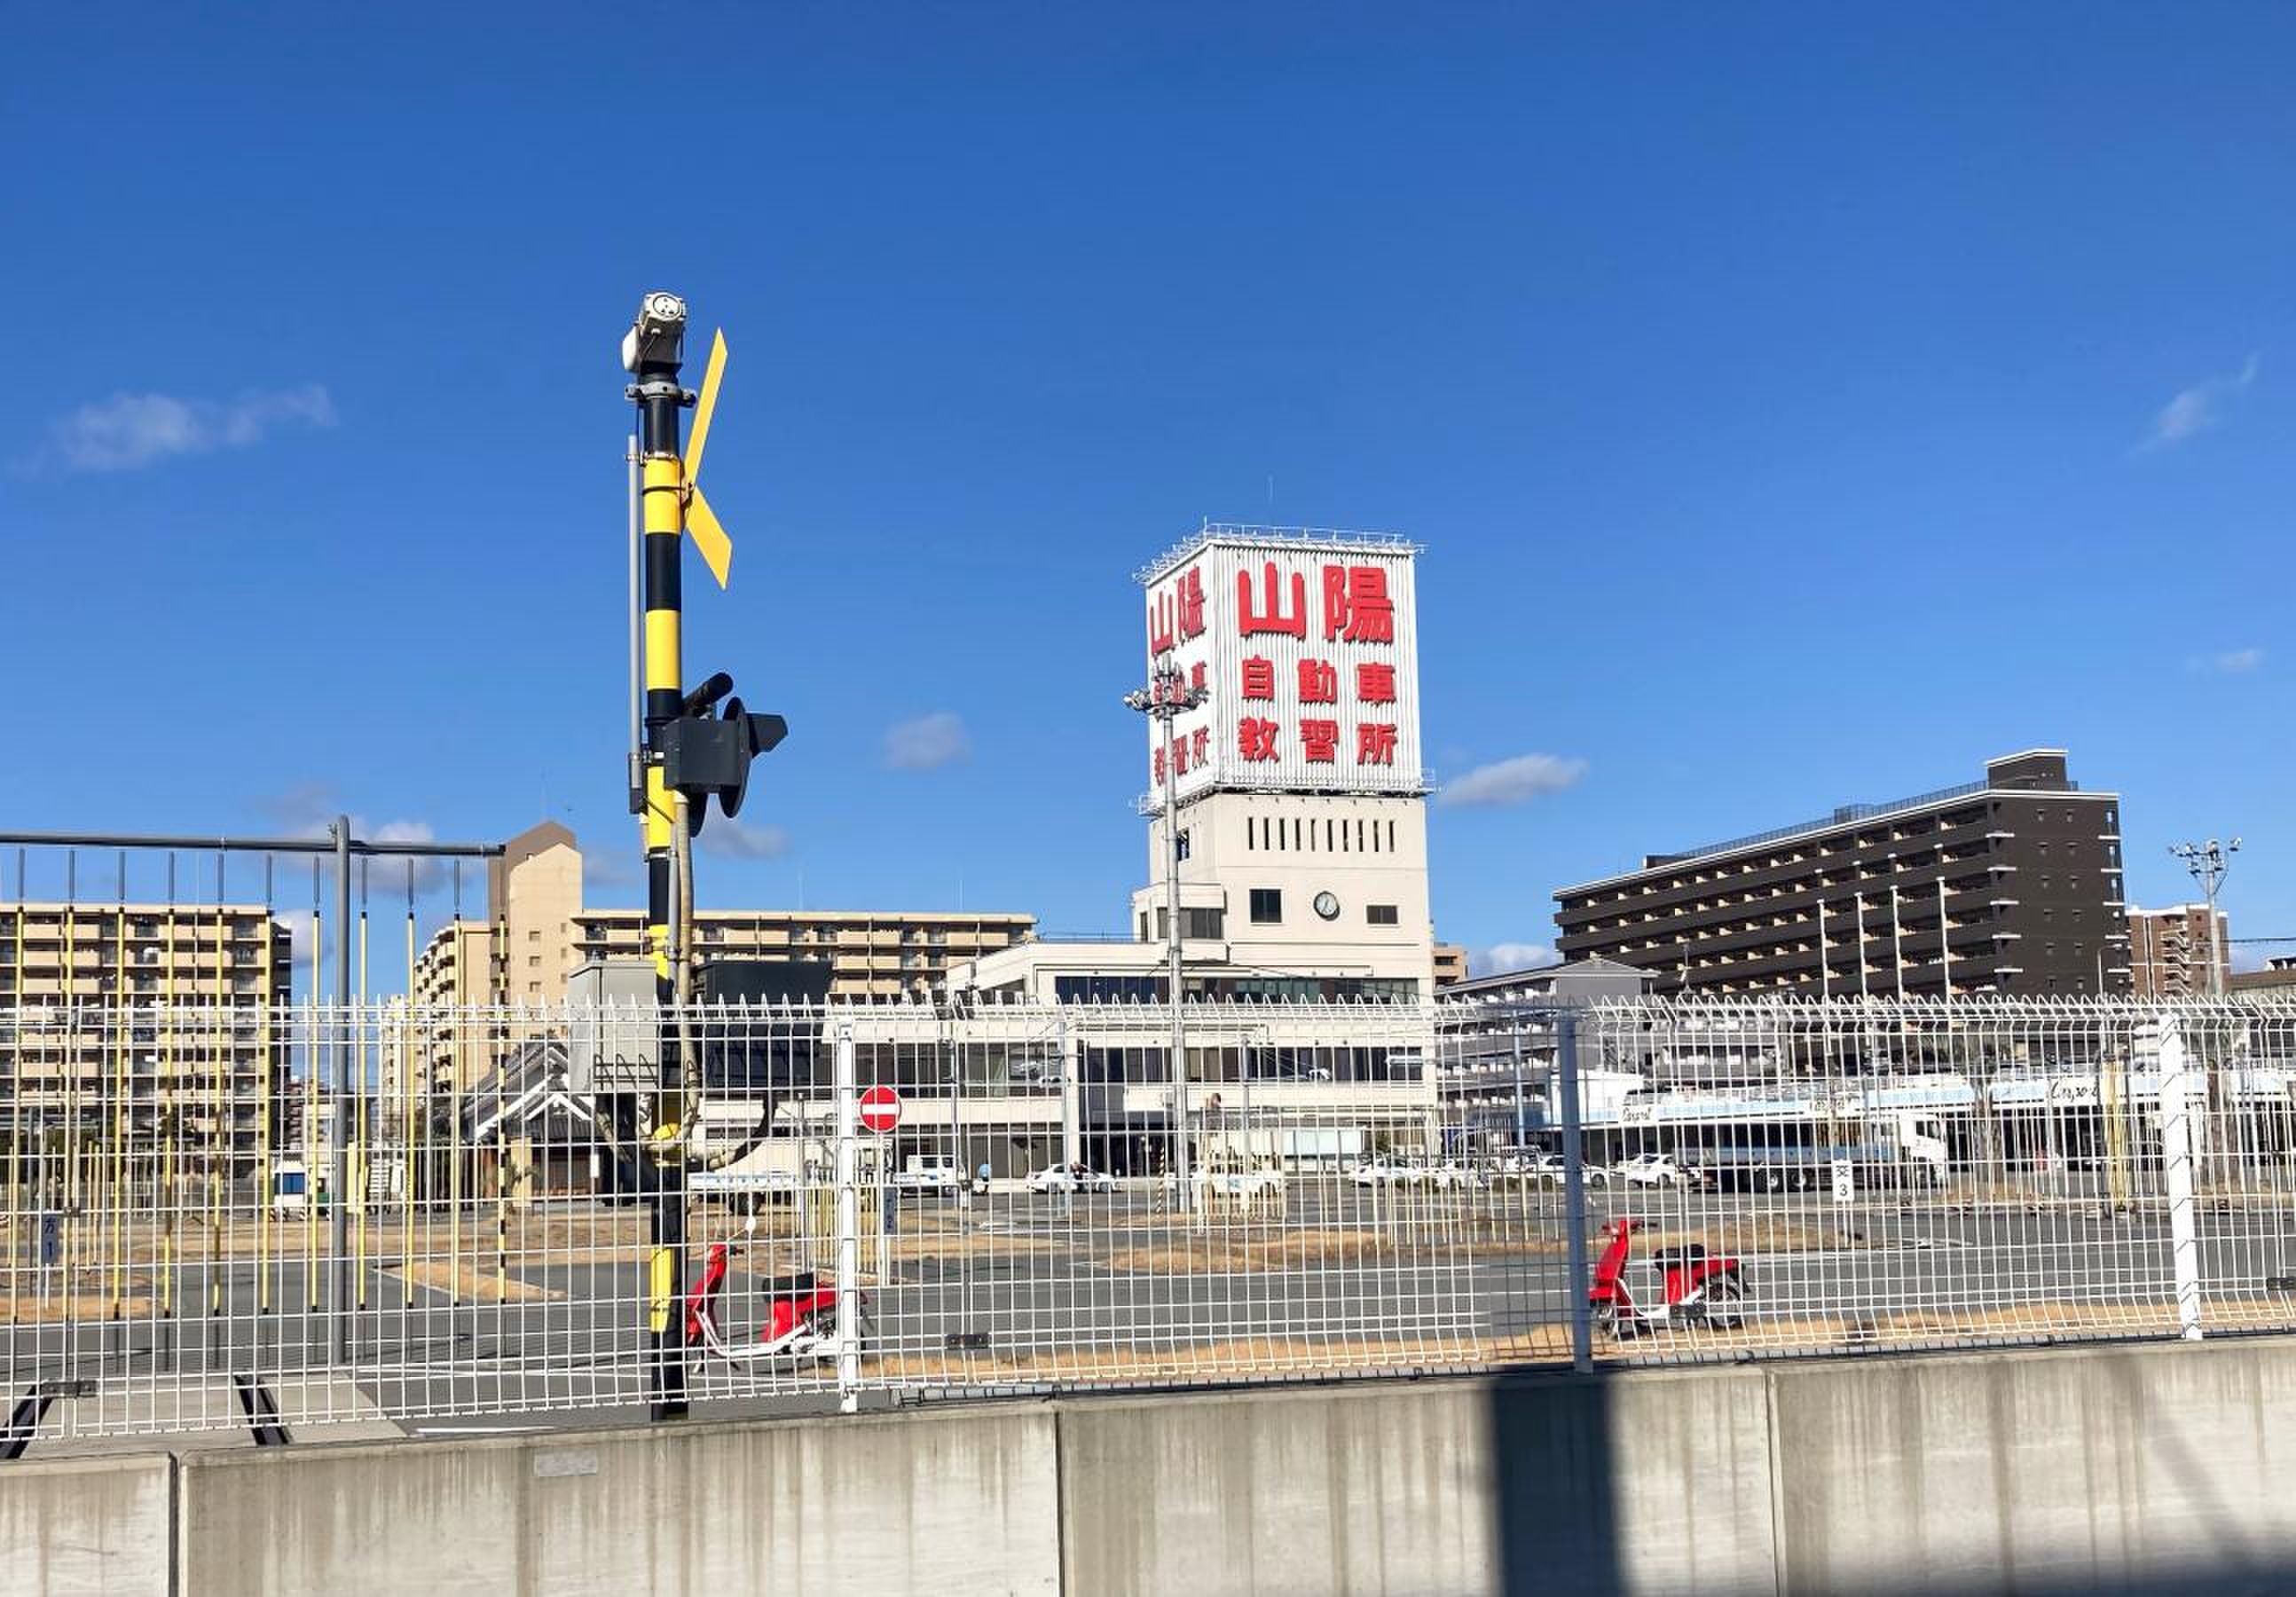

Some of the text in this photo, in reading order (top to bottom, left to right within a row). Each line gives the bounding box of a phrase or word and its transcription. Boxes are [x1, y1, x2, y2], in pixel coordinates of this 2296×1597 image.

[1151, 566, 1206, 655] 山陽
[1238, 562, 1394, 642] 山陽
[1242, 655, 1396, 704] 自動車
[1238, 717, 1397, 766] 教習所
[1839, 1183, 1848, 1197] 3
